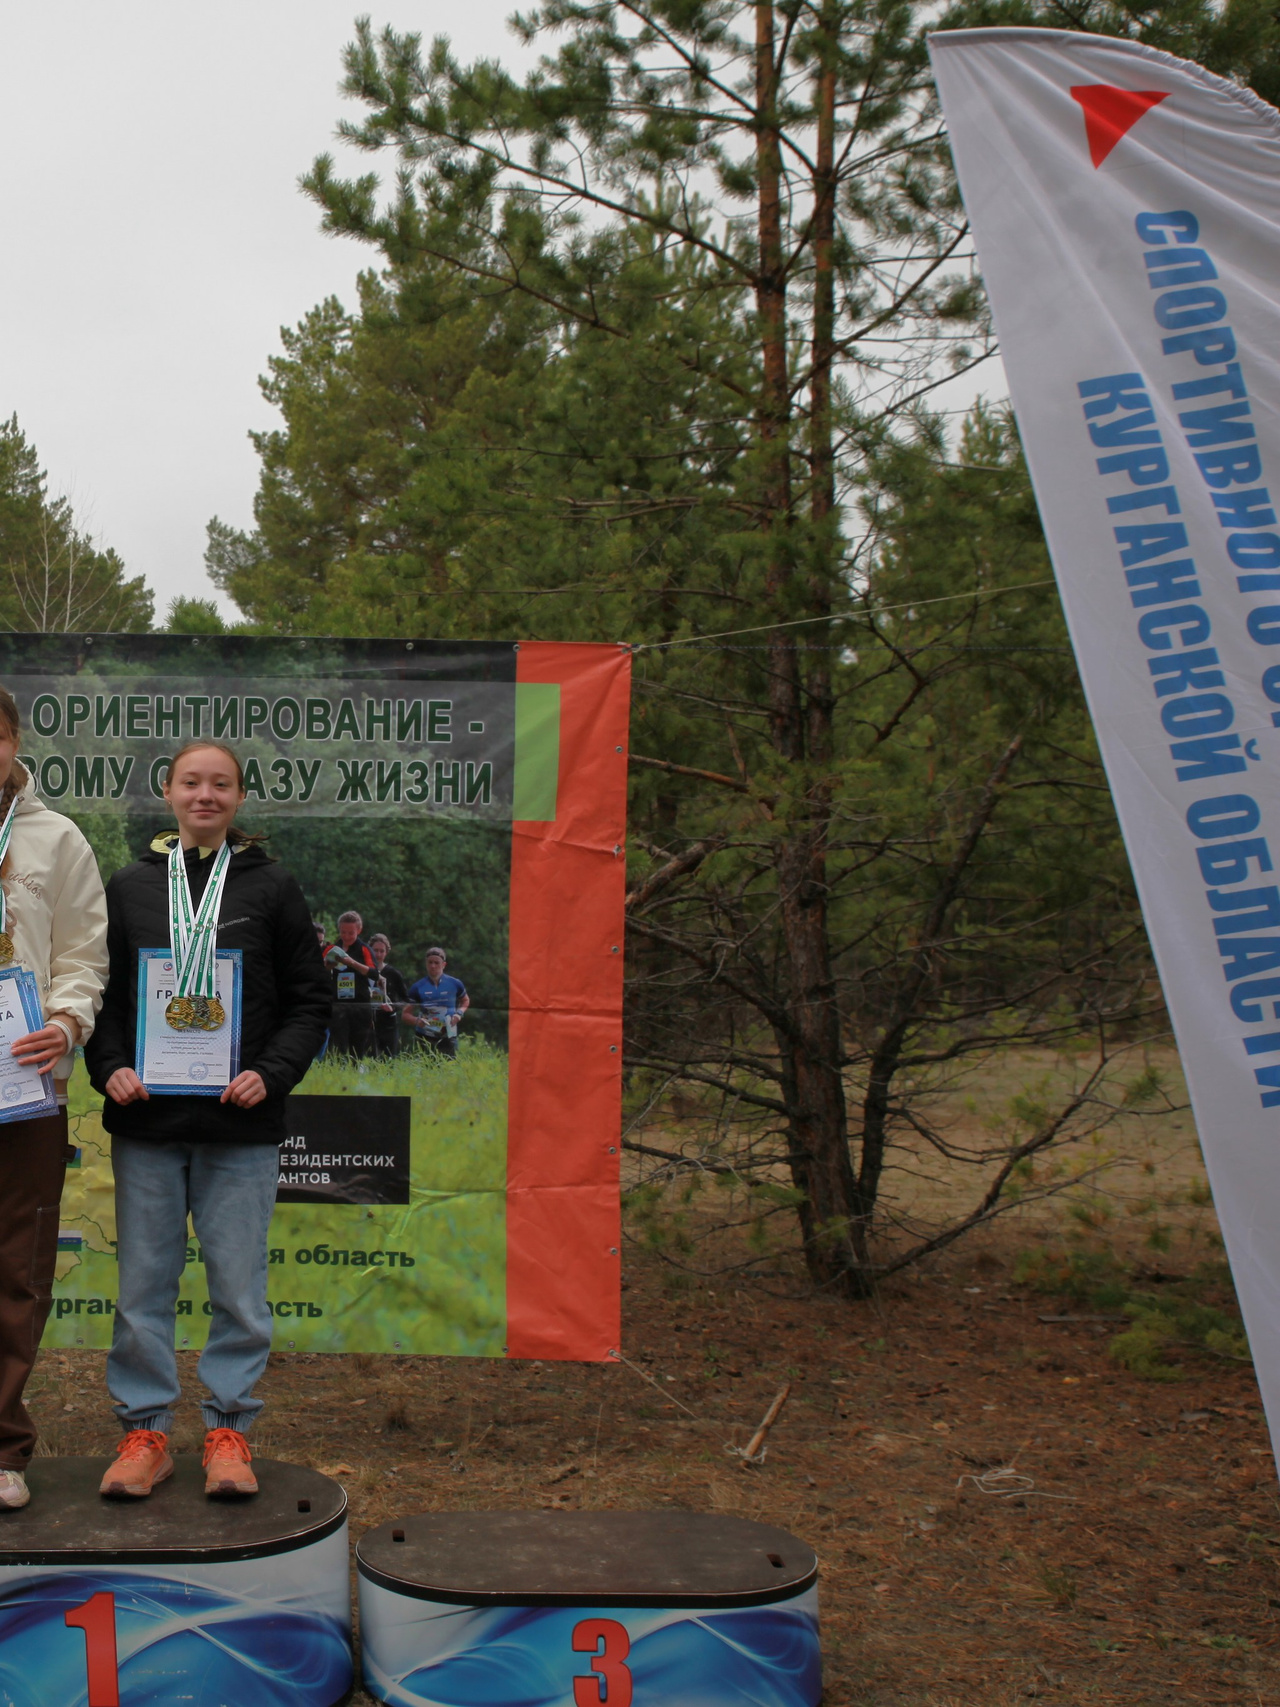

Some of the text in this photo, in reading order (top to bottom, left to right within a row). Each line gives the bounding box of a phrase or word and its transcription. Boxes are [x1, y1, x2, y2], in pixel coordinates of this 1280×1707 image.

[1077, 372, 1261, 782] КУРГАНСКОЙ
[31, 693, 453, 743] ОРИЕНТИРОВАНИЕ
[149, 756, 321, 801] ОАЗУ
[336, 758, 492, 804] ЖИЗНИ
[278, 1136, 306, 1149] НД
[280, 1154, 395, 1167] ЕЗИДЕНТСКИХ
[277, 1172, 331, 1184] АНТОВ
[295, 1244, 415, 1267] область
[64, 1591, 119, 1707] 1
[571, 1617, 632, 1707] 3
